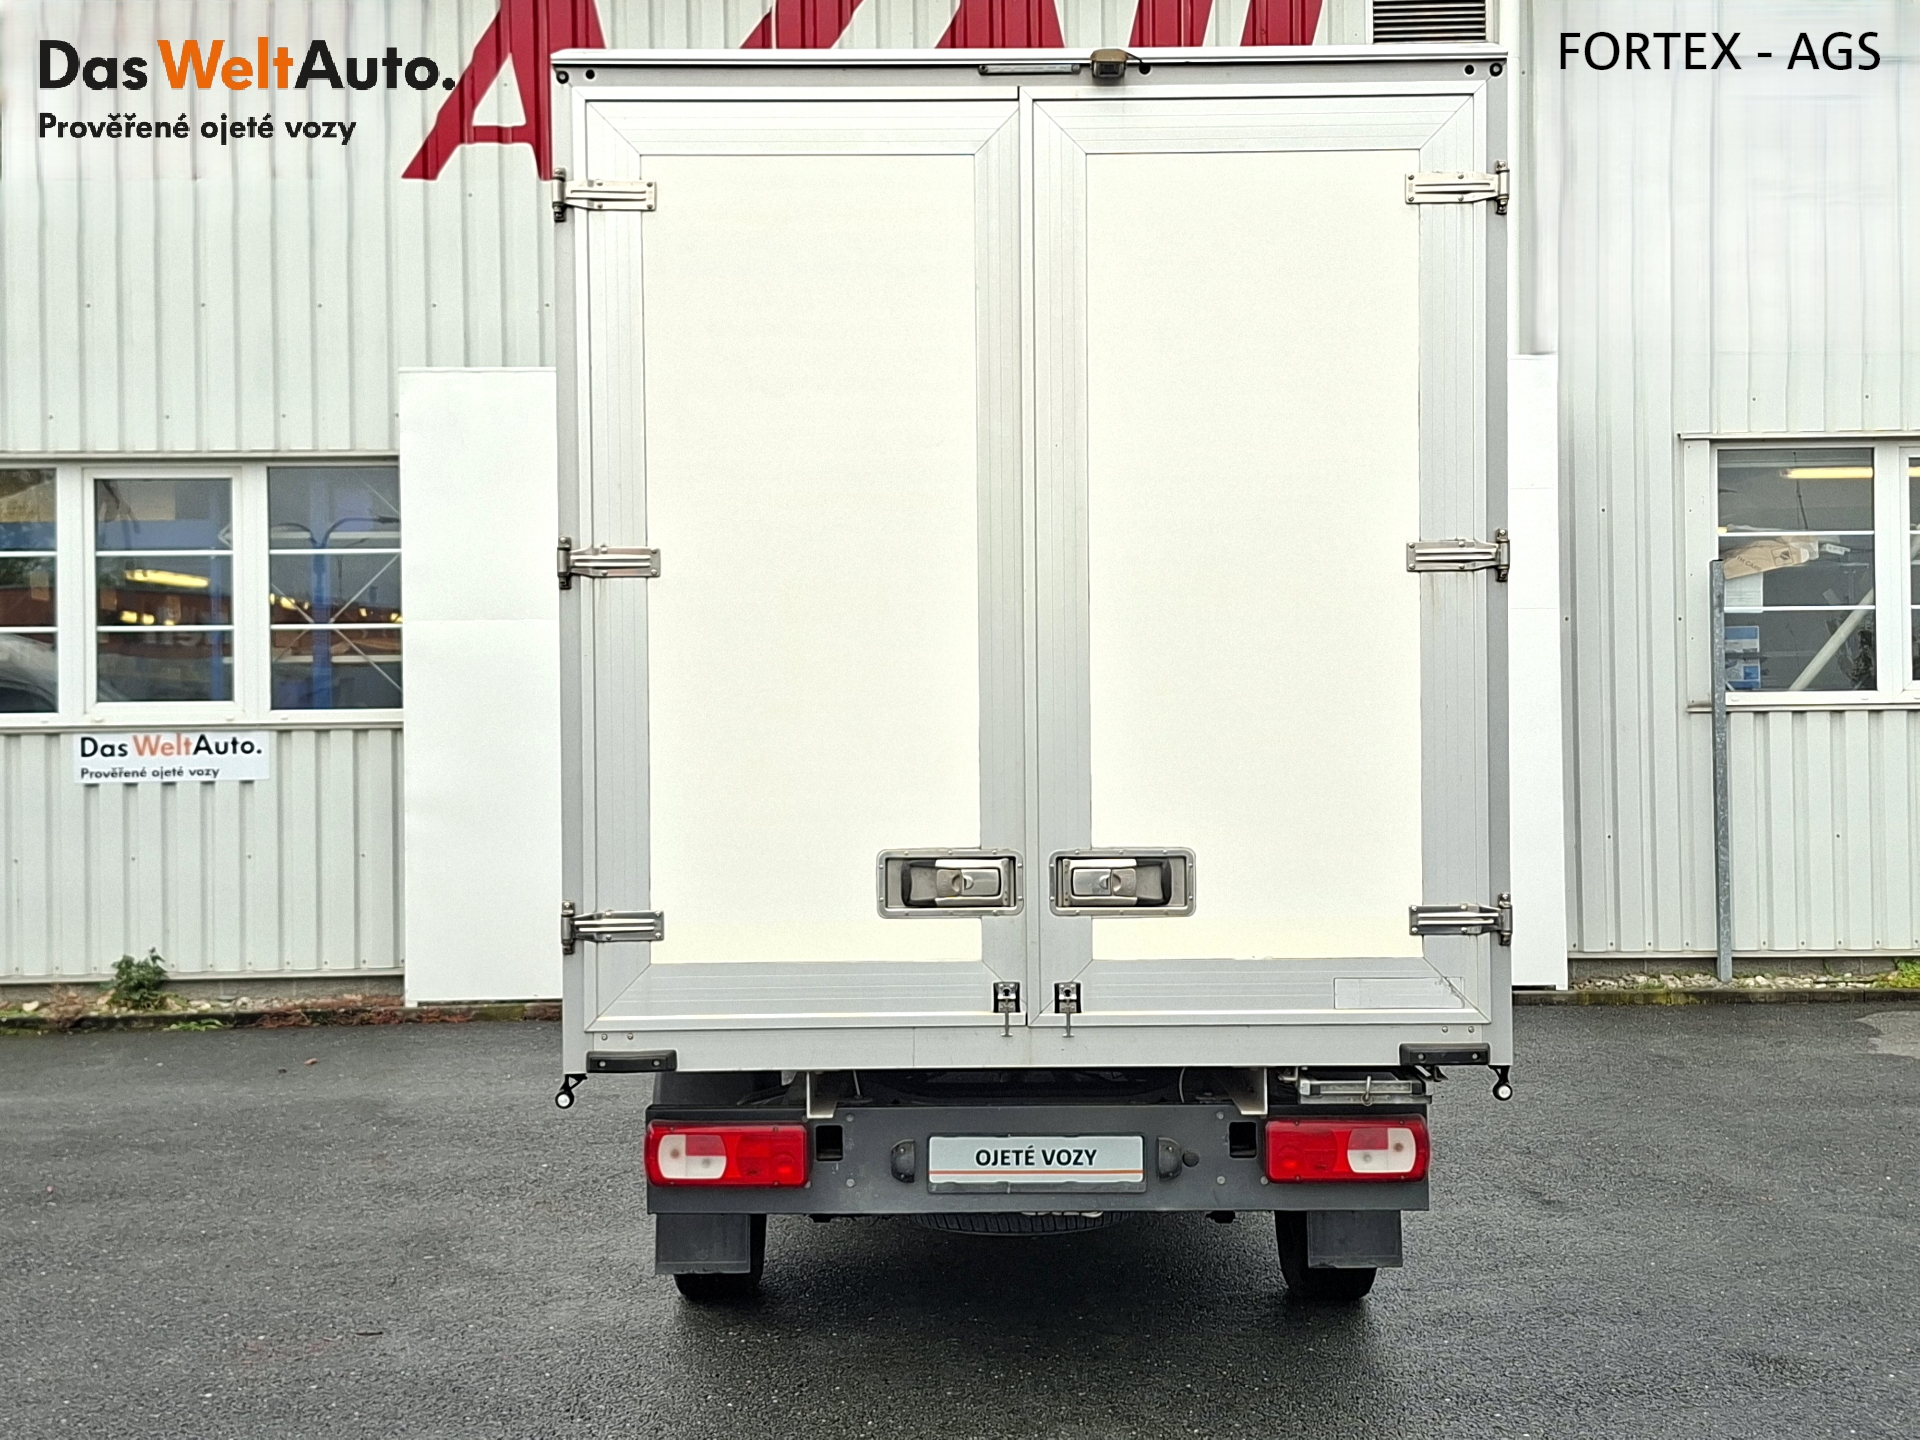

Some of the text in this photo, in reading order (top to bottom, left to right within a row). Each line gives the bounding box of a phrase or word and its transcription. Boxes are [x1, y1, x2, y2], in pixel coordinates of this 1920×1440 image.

[80, 732, 263, 758] Das WeltAuto.
[80, 765, 220, 781] Prověřené ojeté vozy
[975, 1145, 1097, 1166] OJETÉ VOZY
